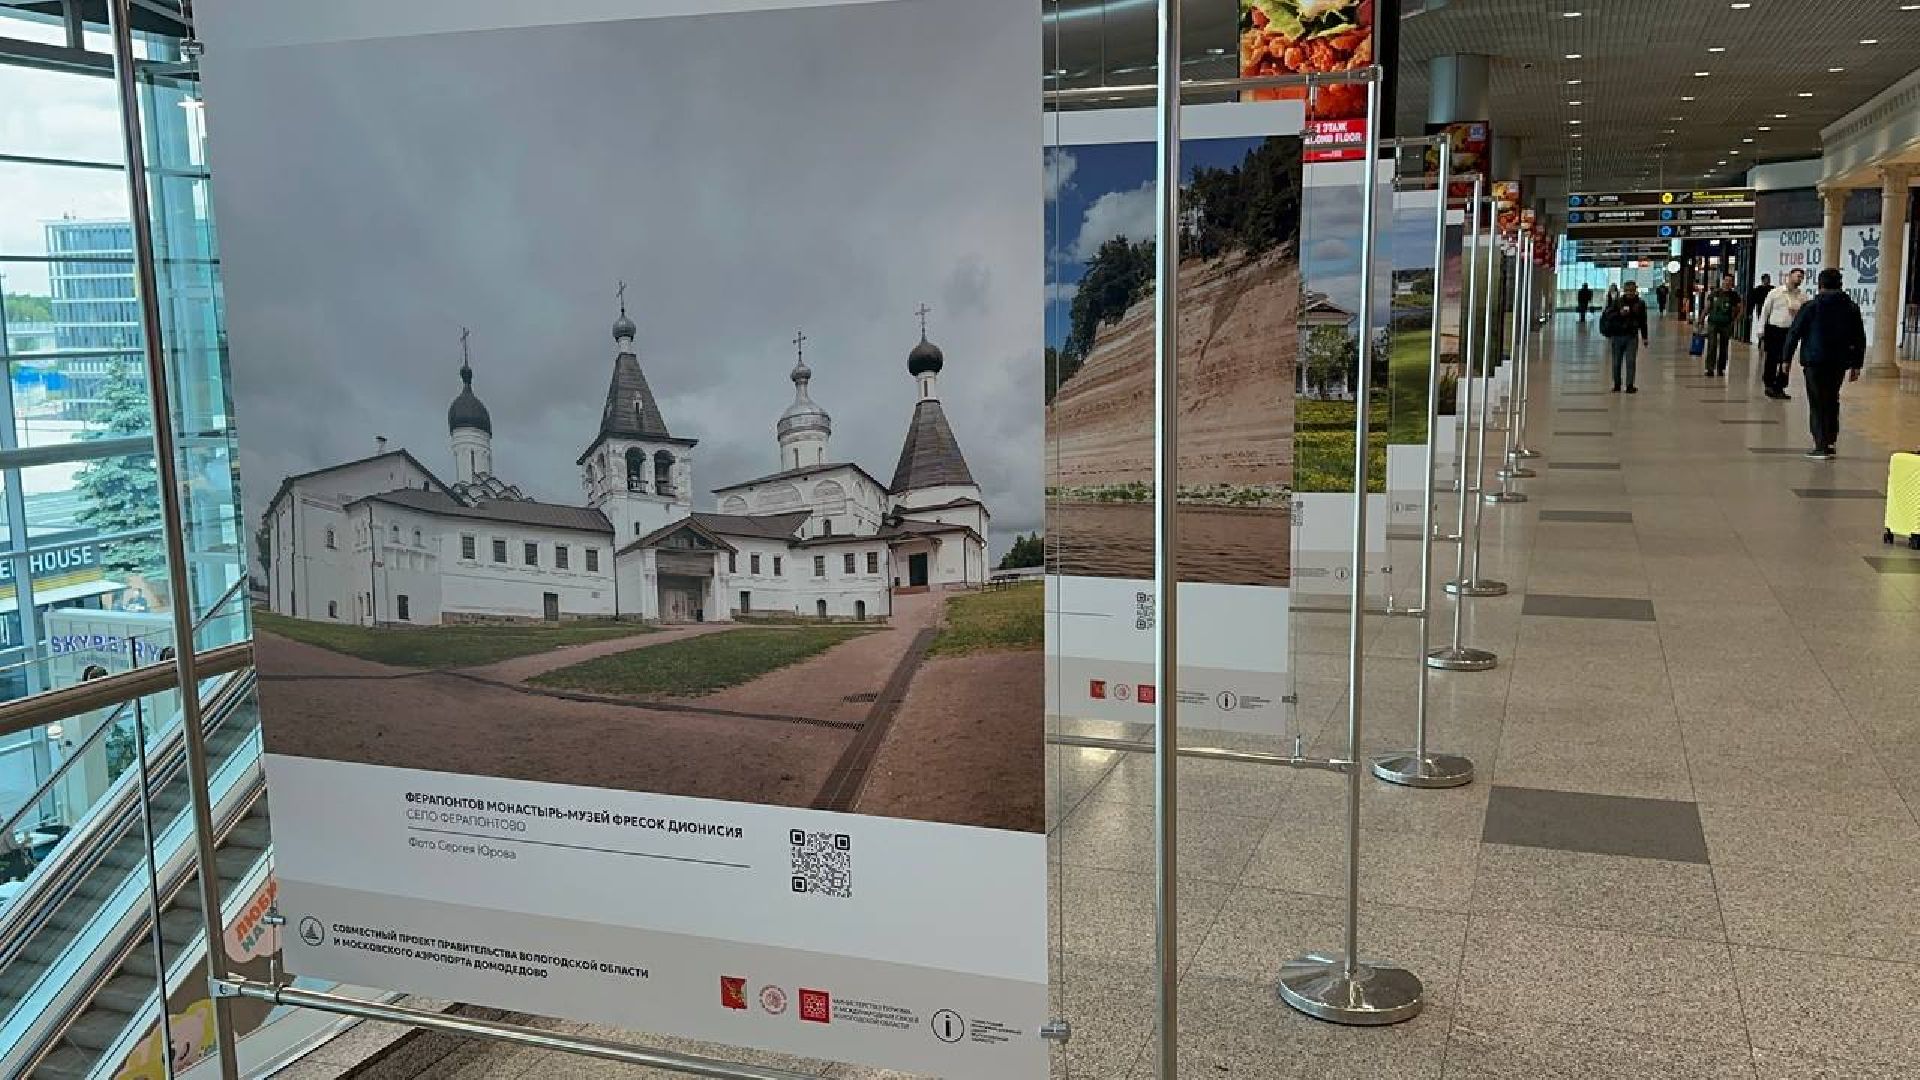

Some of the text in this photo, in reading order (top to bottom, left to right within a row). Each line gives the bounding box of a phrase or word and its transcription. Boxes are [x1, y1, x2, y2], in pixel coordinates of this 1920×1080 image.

[1780, 230, 1819, 246] СКОРО:
[30, 546, 93, 573] HOUSE
[405, 792, 743, 838] ФЕРАПОНТОВ МОНАСТЫРЬ-МУЗЕЙ ФРЕСОК ДИОНИСИЯ
[407, 810, 526, 832] СЕЛО ФЕРАПОНТОВО
[409, 837, 516, 859] Фото Сергея Юрова
[333, 924, 648, 978] СОВМЕСТНЫЙ ПРОЕКТ ПРАВИТЕЛЬСТВА ВОЛОГОДСКОЙ ОБЛАСТИ
[333, 937, 548, 978] И МОСКОВСКОГО АЭРОПОРТА ДОМОДЕДОВО
